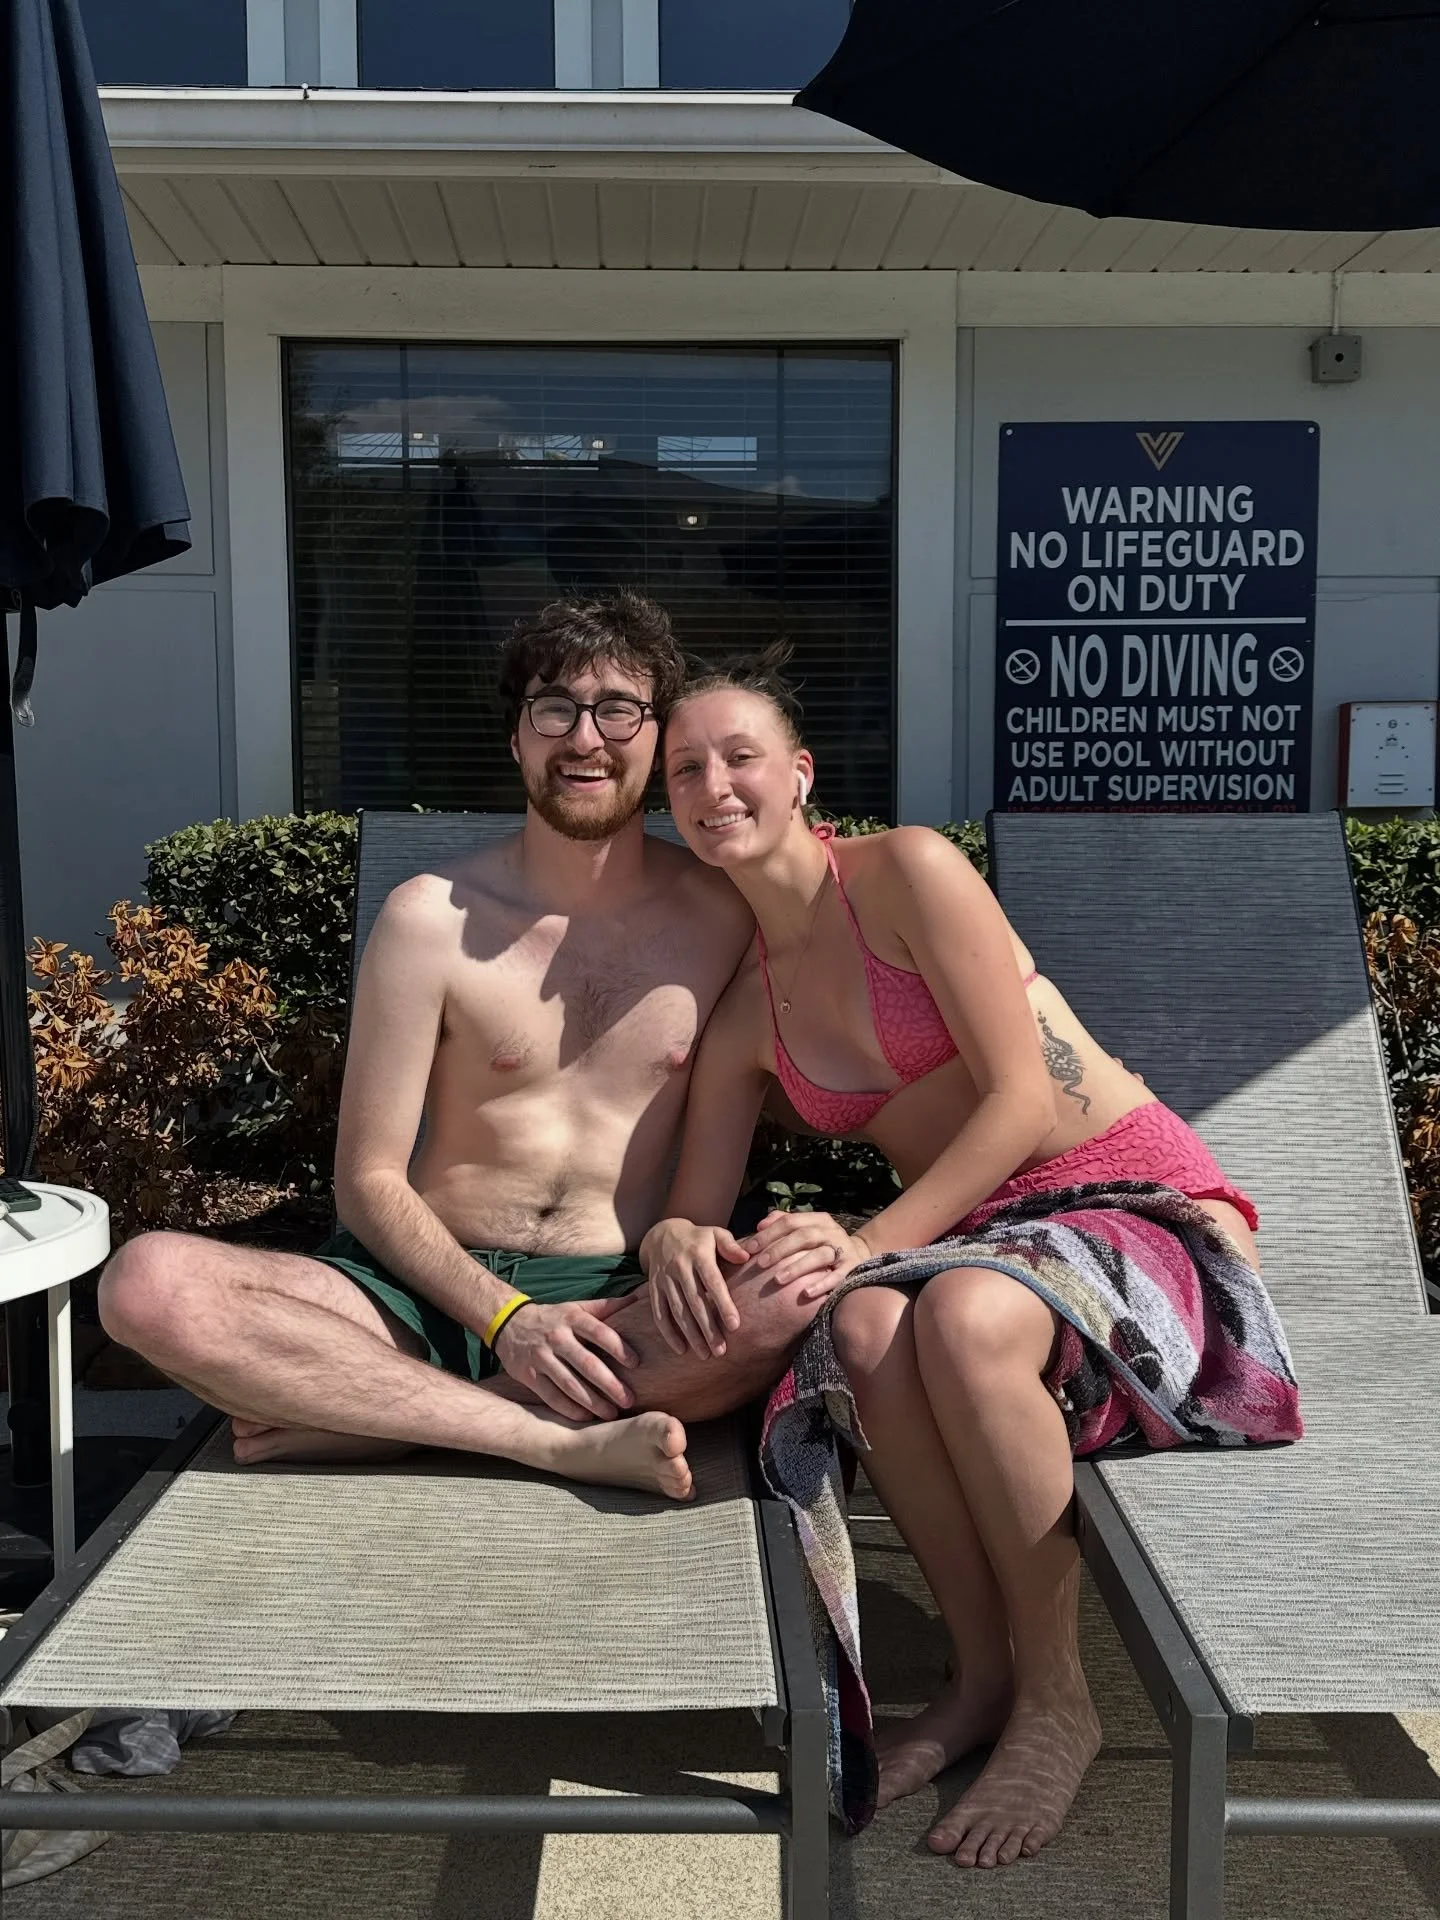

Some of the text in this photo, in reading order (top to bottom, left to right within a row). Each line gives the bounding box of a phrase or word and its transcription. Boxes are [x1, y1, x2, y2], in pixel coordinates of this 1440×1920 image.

[1062, 486, 1254, 524] WARNING
[1010, 530, 1305, 568] NO LIFEGUARD
[1067, 573, 1246, 612] ON DUTY
[1050, 633, 1258, 698] NO DIVING
[1006, 704, 1301, 733] CHILDREN MUST NOT
[1011, 739, 1295, 768] USE POOL WITHOUT
[1008, 773, 1295, 802] ADULT SUPERVISION
